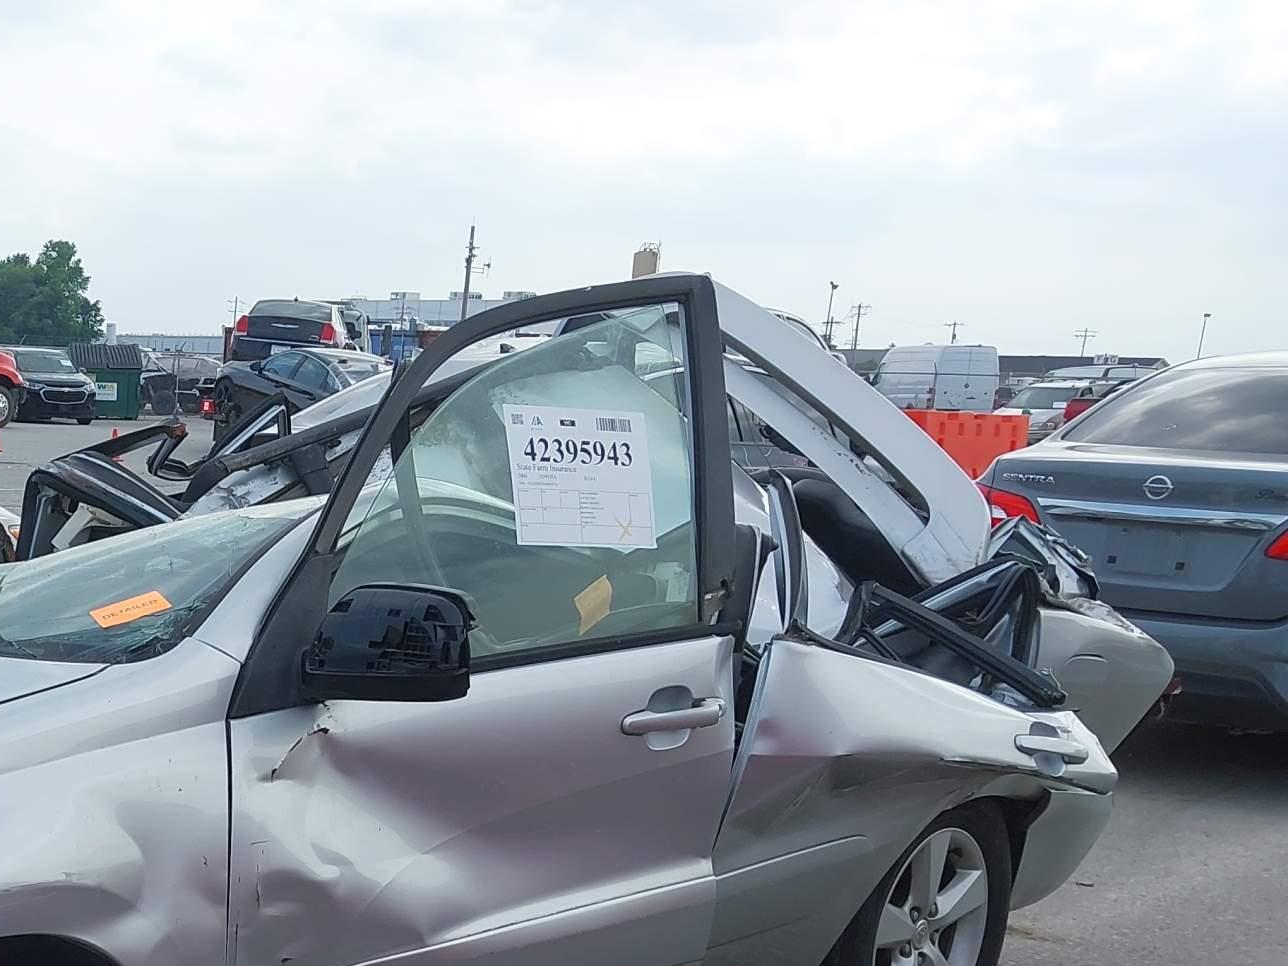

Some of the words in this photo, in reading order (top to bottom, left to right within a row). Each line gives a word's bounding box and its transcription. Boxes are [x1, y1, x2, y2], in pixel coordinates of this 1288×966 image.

[523, 436, 633, 467] 42395943
[516, 463, 532, 471] State
[532, 464, 549, 472] Farm
[549, 465, 577, 473] Insurance
[1001, 472, 1056, 485] SENTRA
[102, 599, 158, 620] DETAILED
